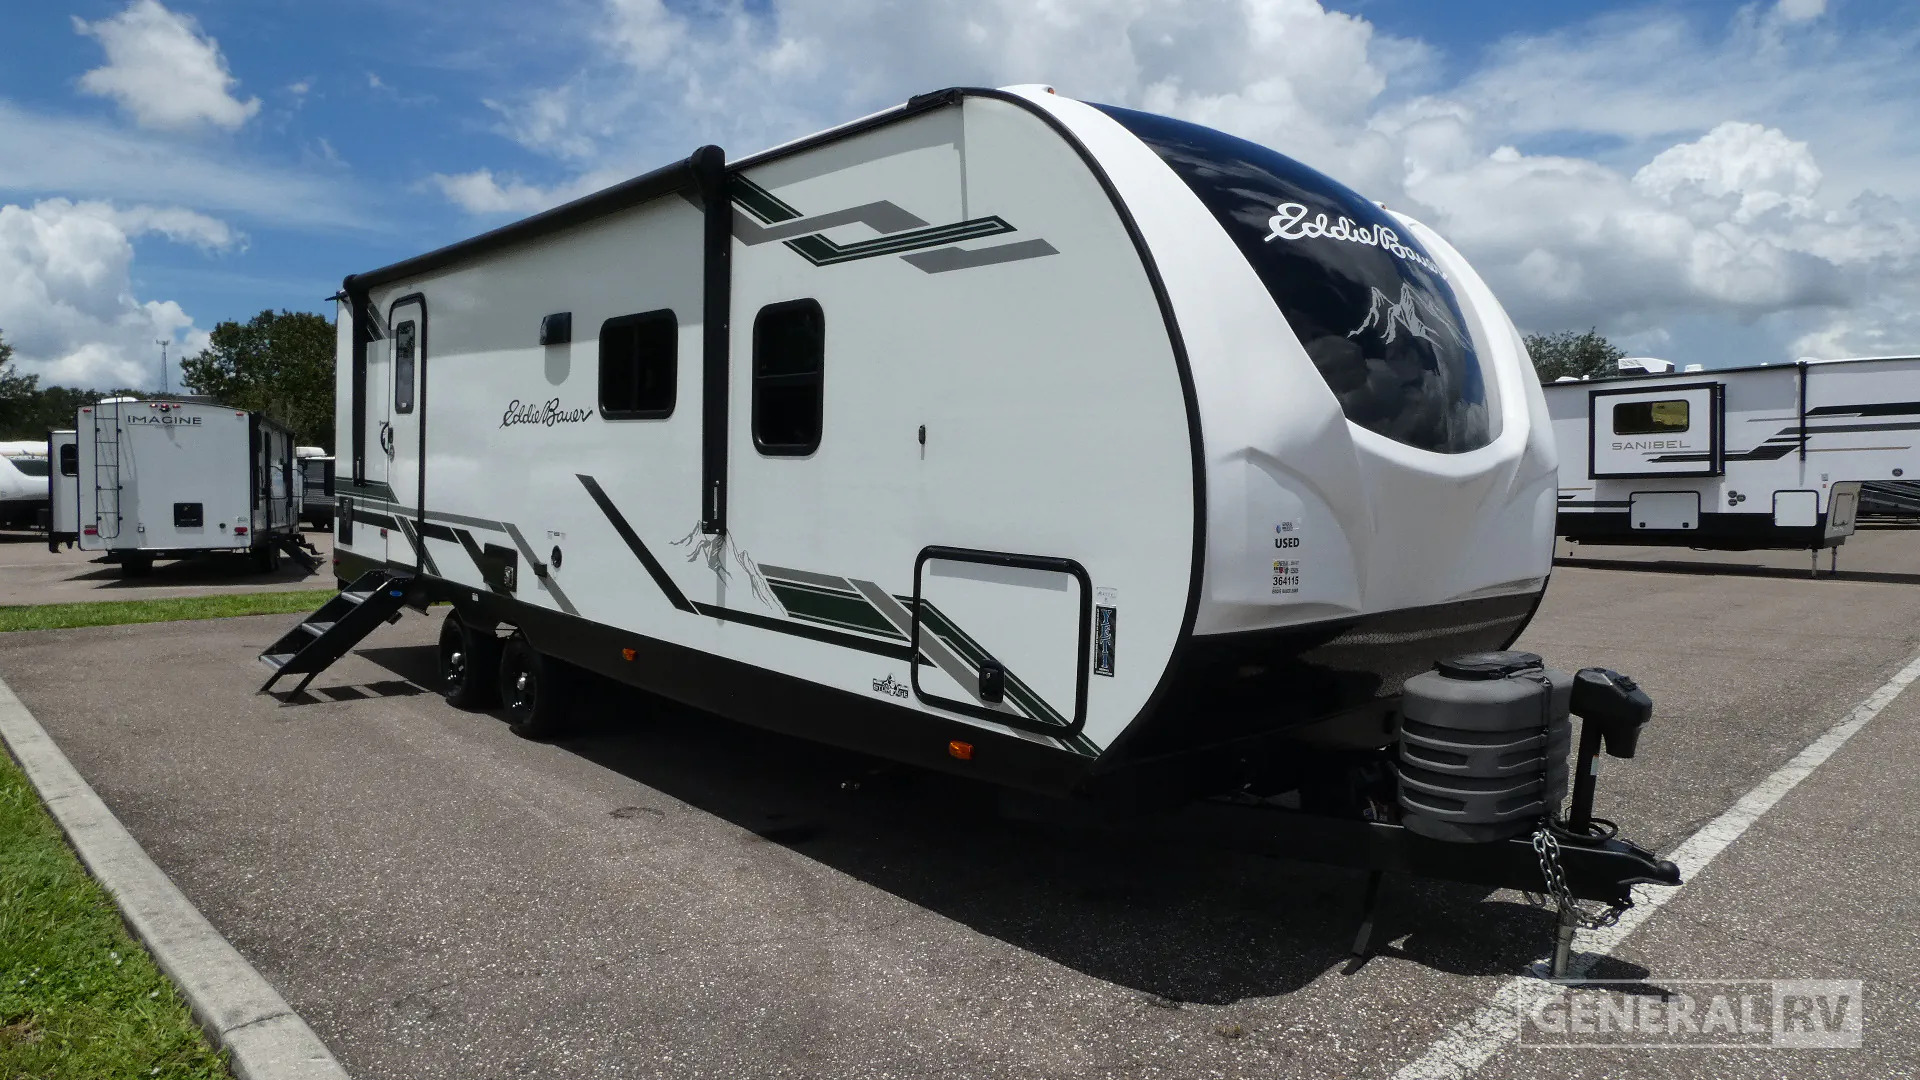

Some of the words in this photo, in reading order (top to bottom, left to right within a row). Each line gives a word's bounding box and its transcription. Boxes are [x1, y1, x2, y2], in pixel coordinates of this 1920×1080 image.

[1264, 202, 1377, 246] Eddie
[1376, 223, 1448, 280] Bauer
[499, 399, 541, 429] Eddie
[541, 397, 594, 427] Bauer
[127, 415, 202, 425] IMAGINE
[1612, 440, 1691, 451] SANIBEL
[1275, 537, 1300, 549] USED
[1272, 576, 1299, 586] 364115
